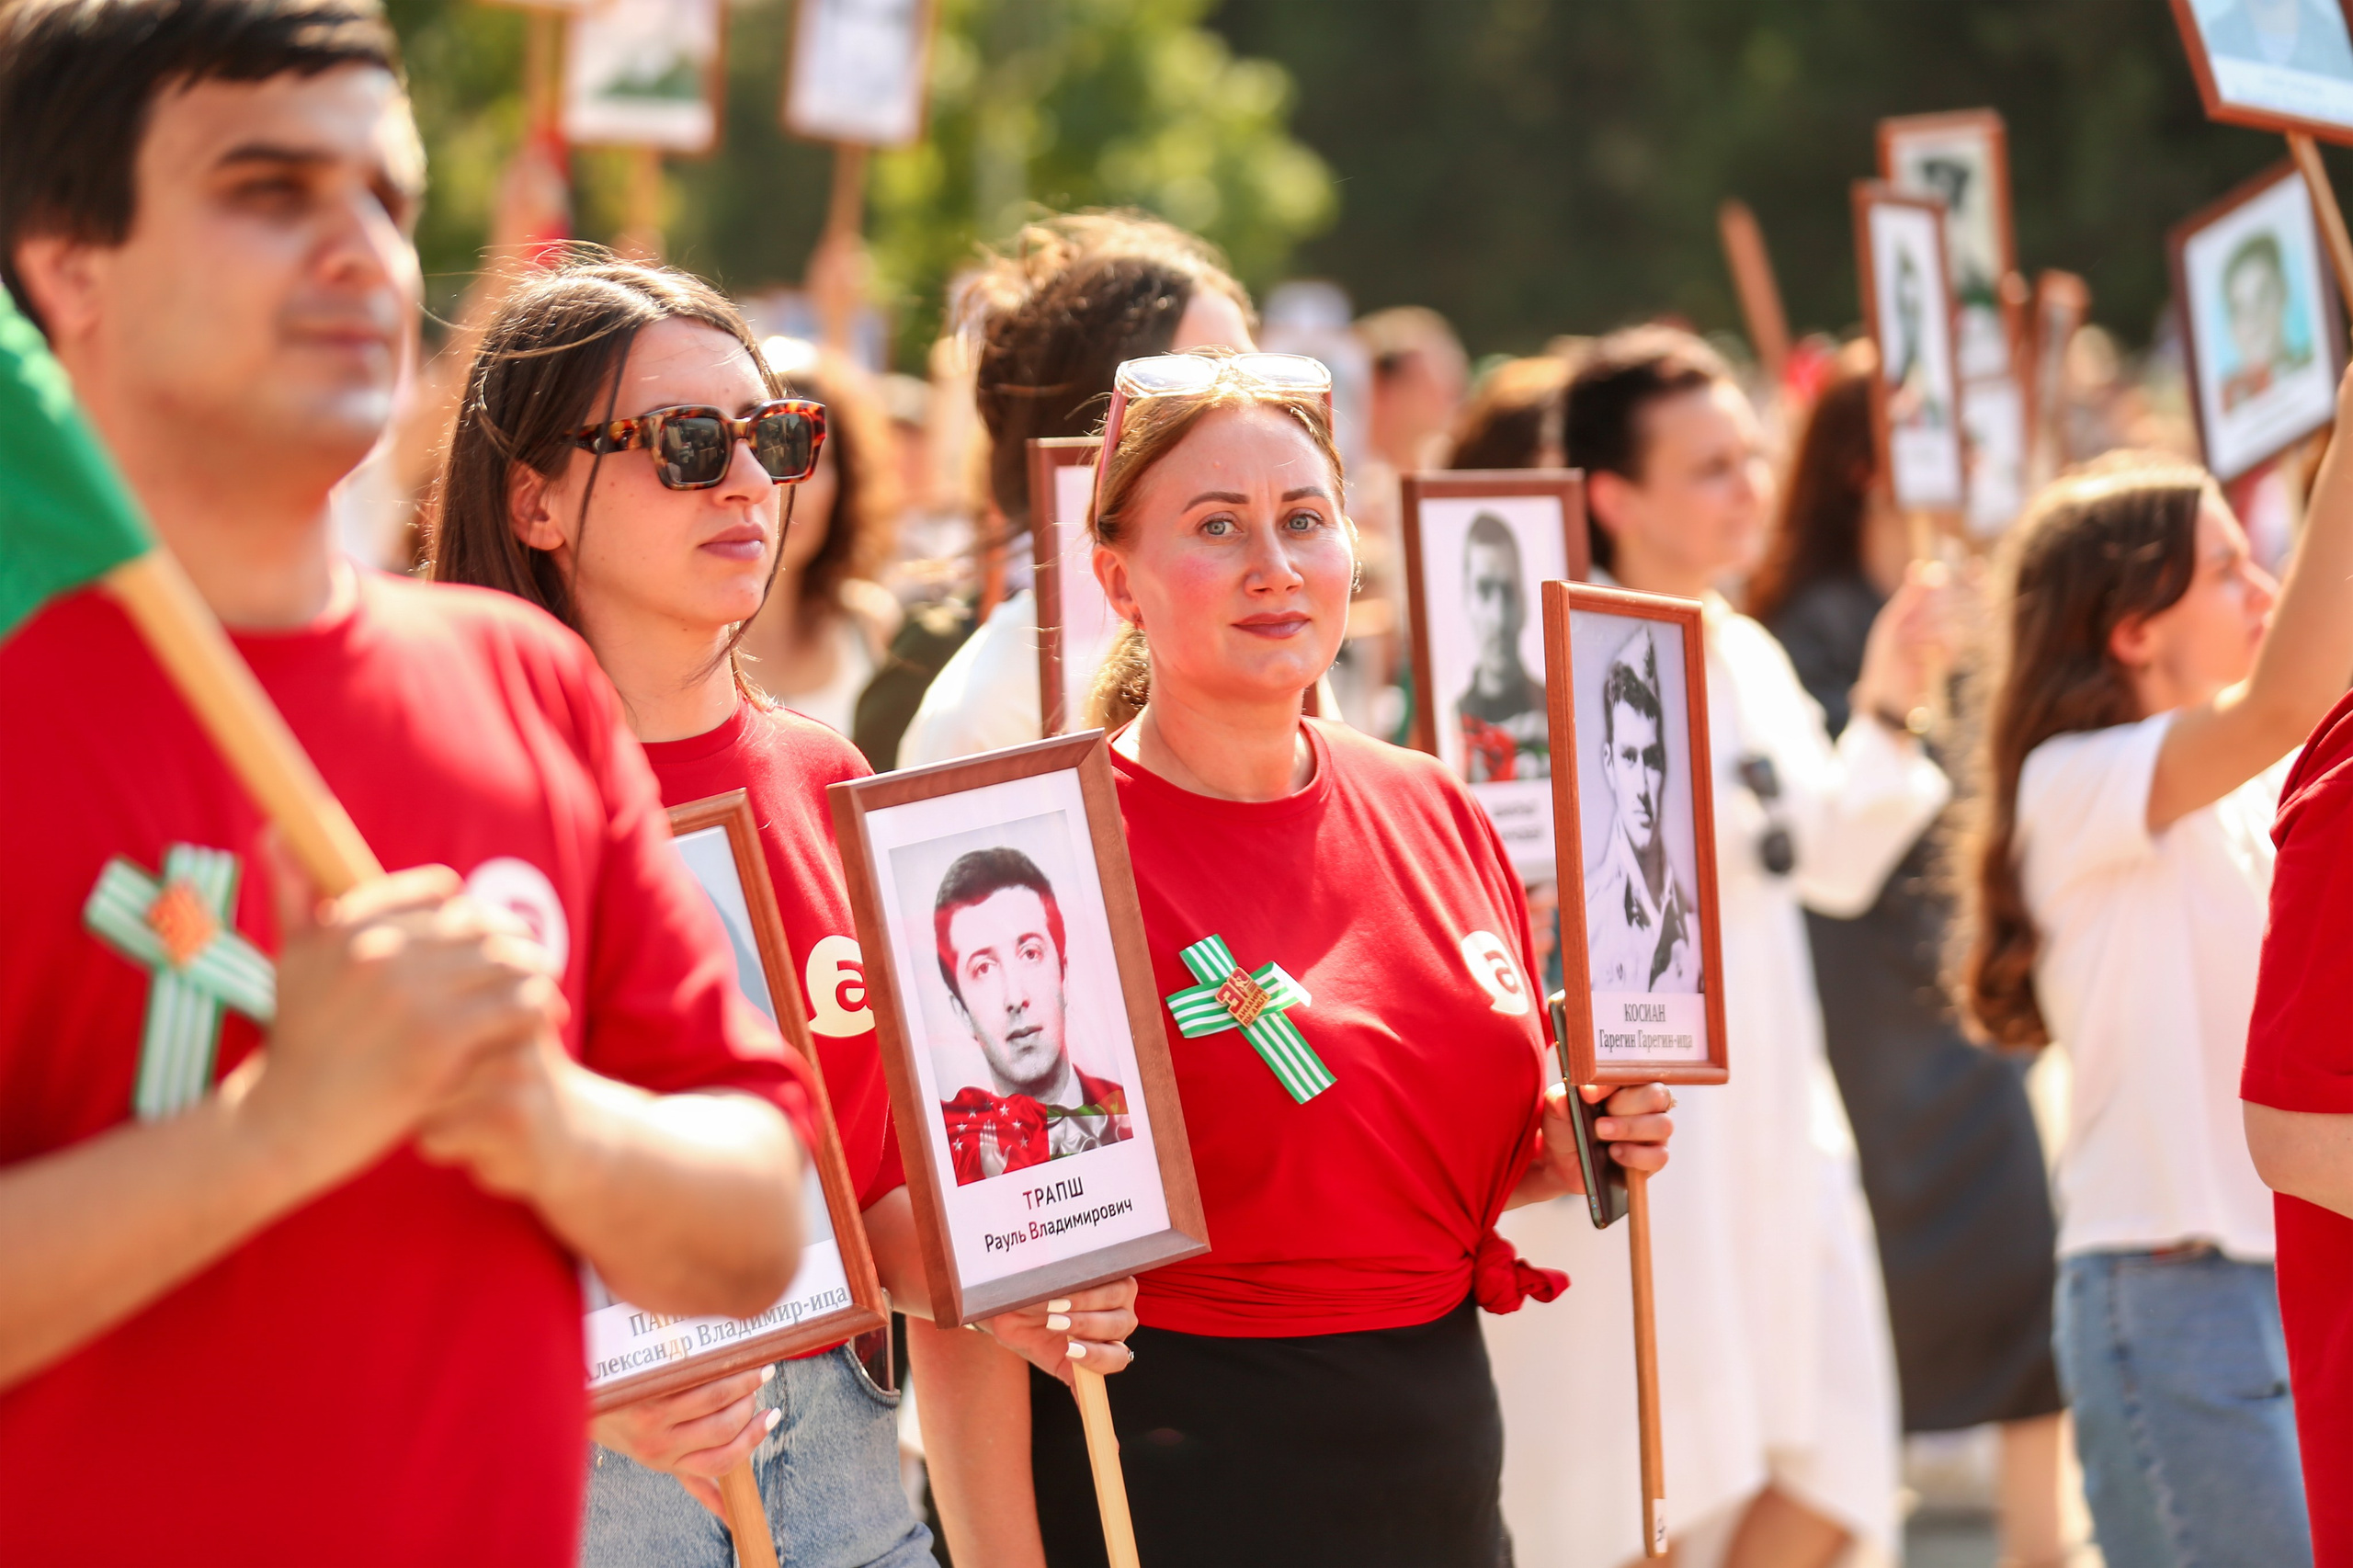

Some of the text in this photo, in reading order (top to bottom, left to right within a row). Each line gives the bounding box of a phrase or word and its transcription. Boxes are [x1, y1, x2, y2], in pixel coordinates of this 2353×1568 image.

[1623, 1003, 1666, 1022] КОСИАН
[1598, 1028, 1694, 1052] Гарегин Гарегин-ица
[1022, 1176, 1084, 1210] ТРАПШ
[984, 1198, 1133, 1253] Рауль Владимирович
[590, 1335, 693, 1381] лександр
[696, 1286, 848, 1346] Владимир-ица
